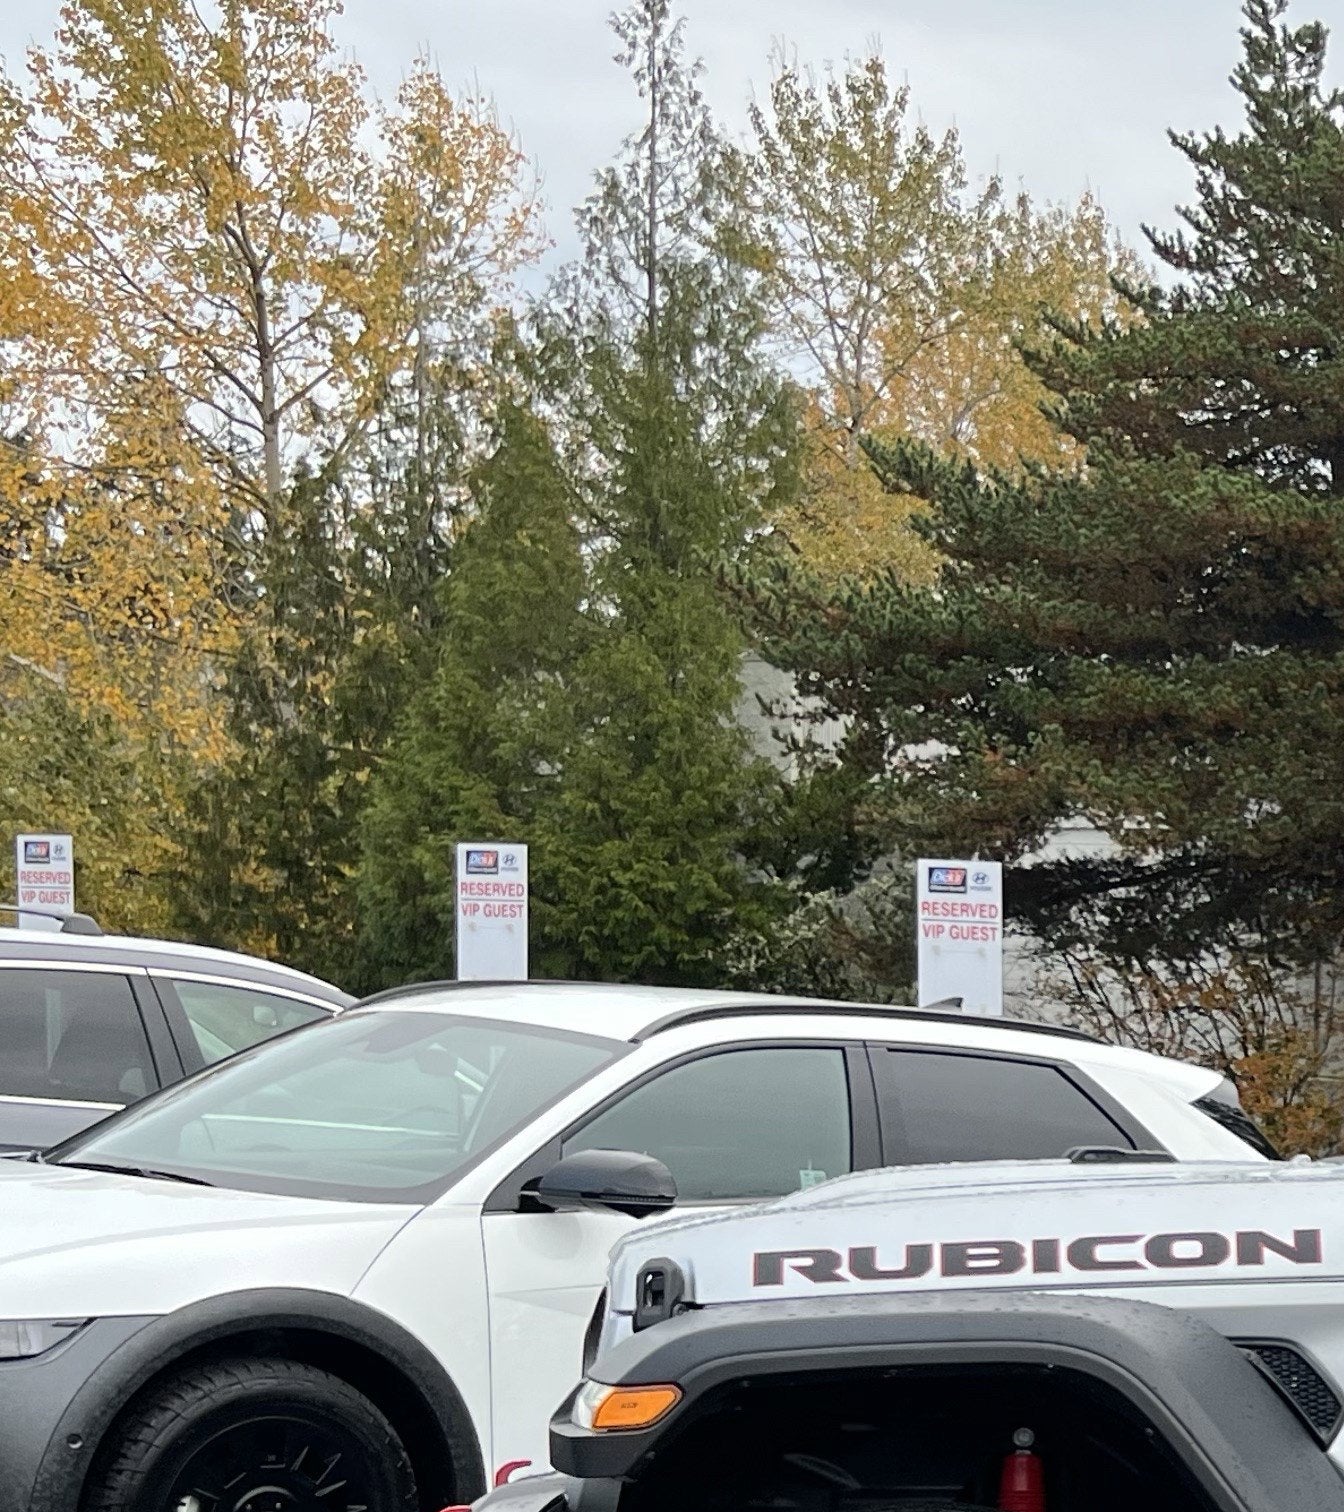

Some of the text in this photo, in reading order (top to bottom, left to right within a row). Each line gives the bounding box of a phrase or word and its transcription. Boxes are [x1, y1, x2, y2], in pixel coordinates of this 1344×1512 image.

[20, 870, 71, 885] RESERVED
[21, 890, 71, 904] VIP GUEST
[460, 882, 525, 897] RESERVED
[461, 903, 524, 918] VIP GUEST
[921, 901, 999, 919] RESERVED
[922, 923, 998, 941] VIP GUEST
[752, 1228, 1323, 1287] RUBICON
